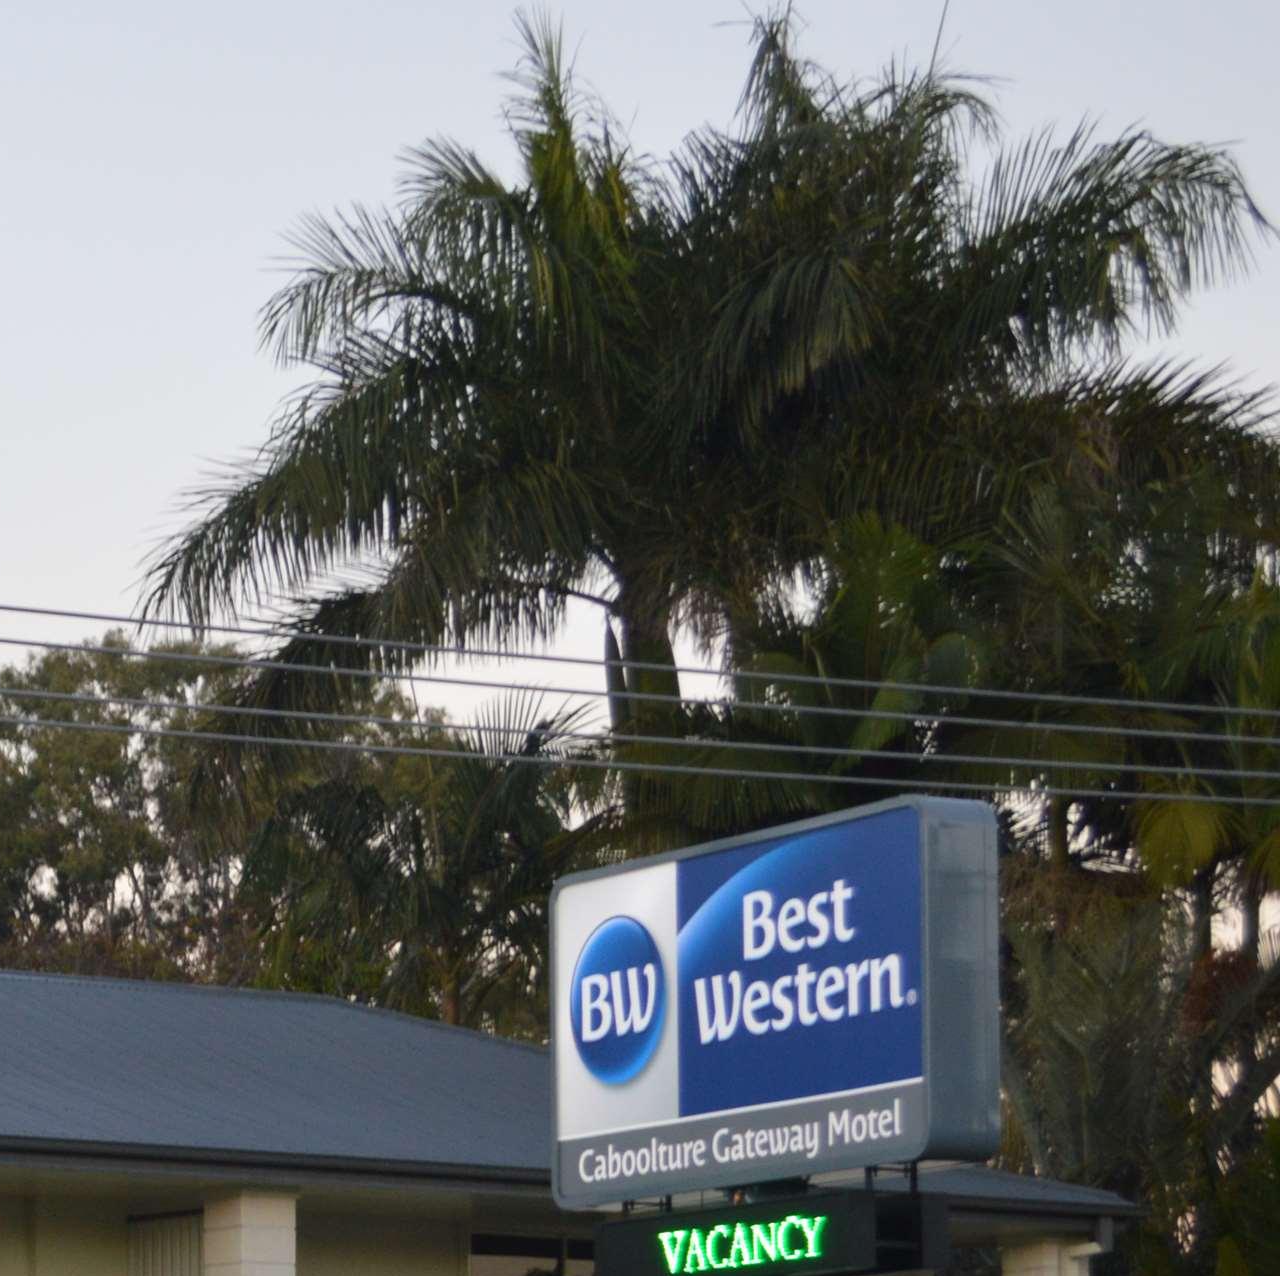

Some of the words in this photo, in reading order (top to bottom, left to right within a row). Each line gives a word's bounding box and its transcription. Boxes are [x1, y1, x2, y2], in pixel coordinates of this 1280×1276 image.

[742, 878, 856, 961] Best
[580, 963, 657, 1043] BW
[693, 952, 906, 1046] Western
[578, 1136, 706, 1184] Caboolture
[712, 1120, 821, 1164] Gateway
[828, 1097, 902, 1147] Motel
[657, 1215, 828, 1274] VACANCY
